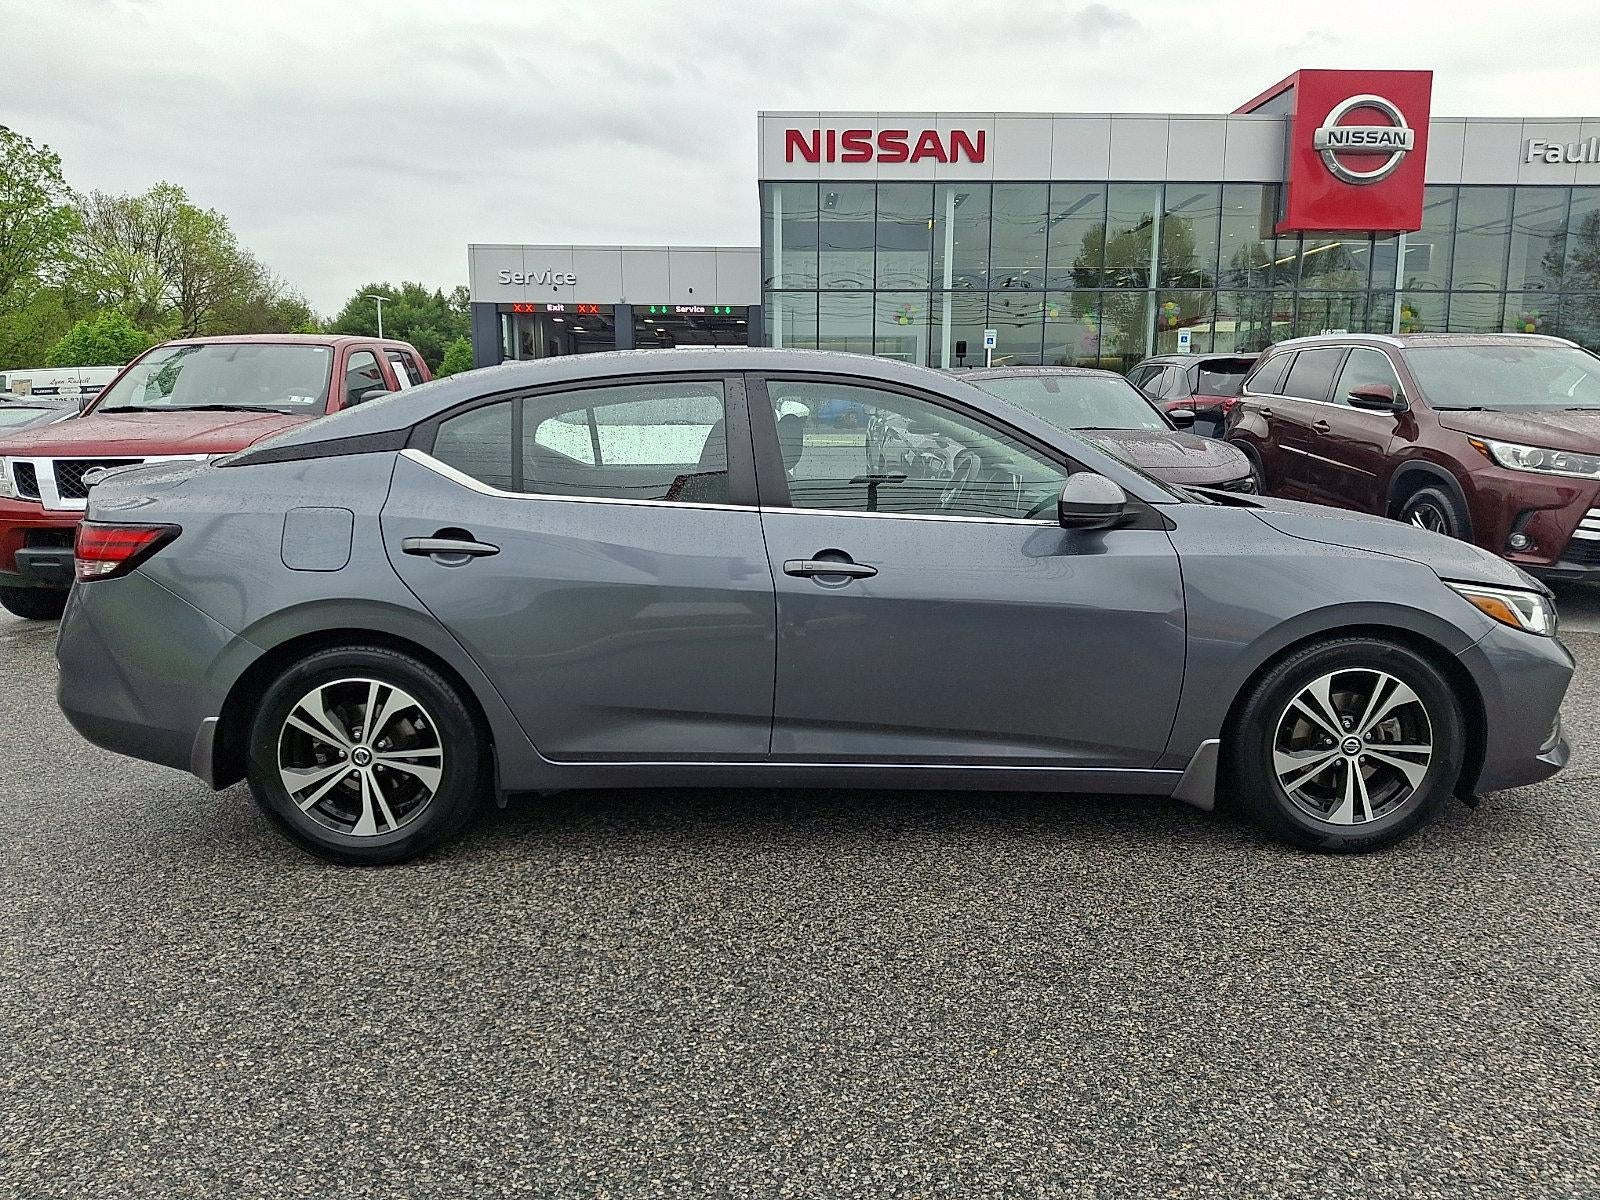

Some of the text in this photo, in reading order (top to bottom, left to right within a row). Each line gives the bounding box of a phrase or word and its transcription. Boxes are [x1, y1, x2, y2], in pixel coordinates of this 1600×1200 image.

[785, 129, 986, 164] NISSAN
[1327, 130, 1407, 146] NISSAN
[1526, 137, 1600, 163] Faul
[498, 267, 577, 285] Service
[546, 304, 565, 312] Exit
